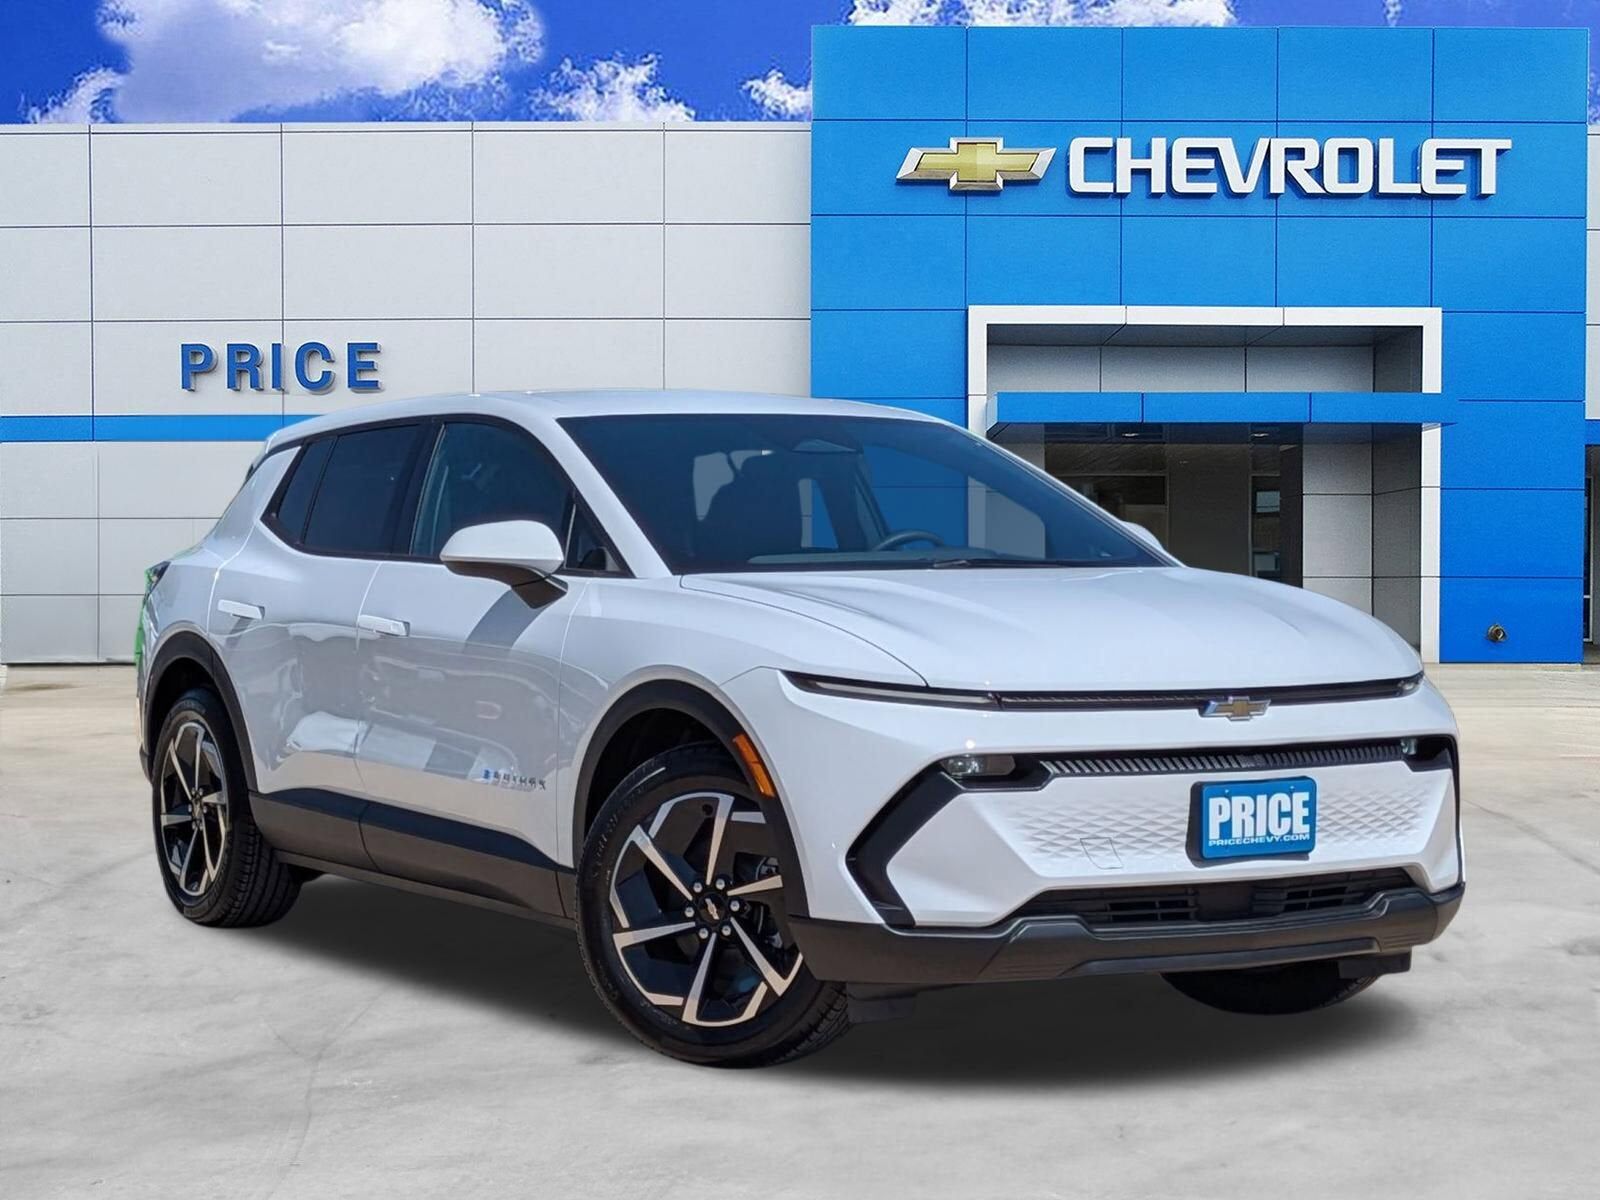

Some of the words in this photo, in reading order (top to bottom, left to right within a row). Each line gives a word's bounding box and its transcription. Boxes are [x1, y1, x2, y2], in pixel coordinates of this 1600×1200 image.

[1068, 137, 1512, 195] CHEVROLET
[181, 341, 381, 392] PRICE
[1208, 791, 1310, 840] PRICE
[1208, 834, 1310, 847] PRICECHEVY.COM
